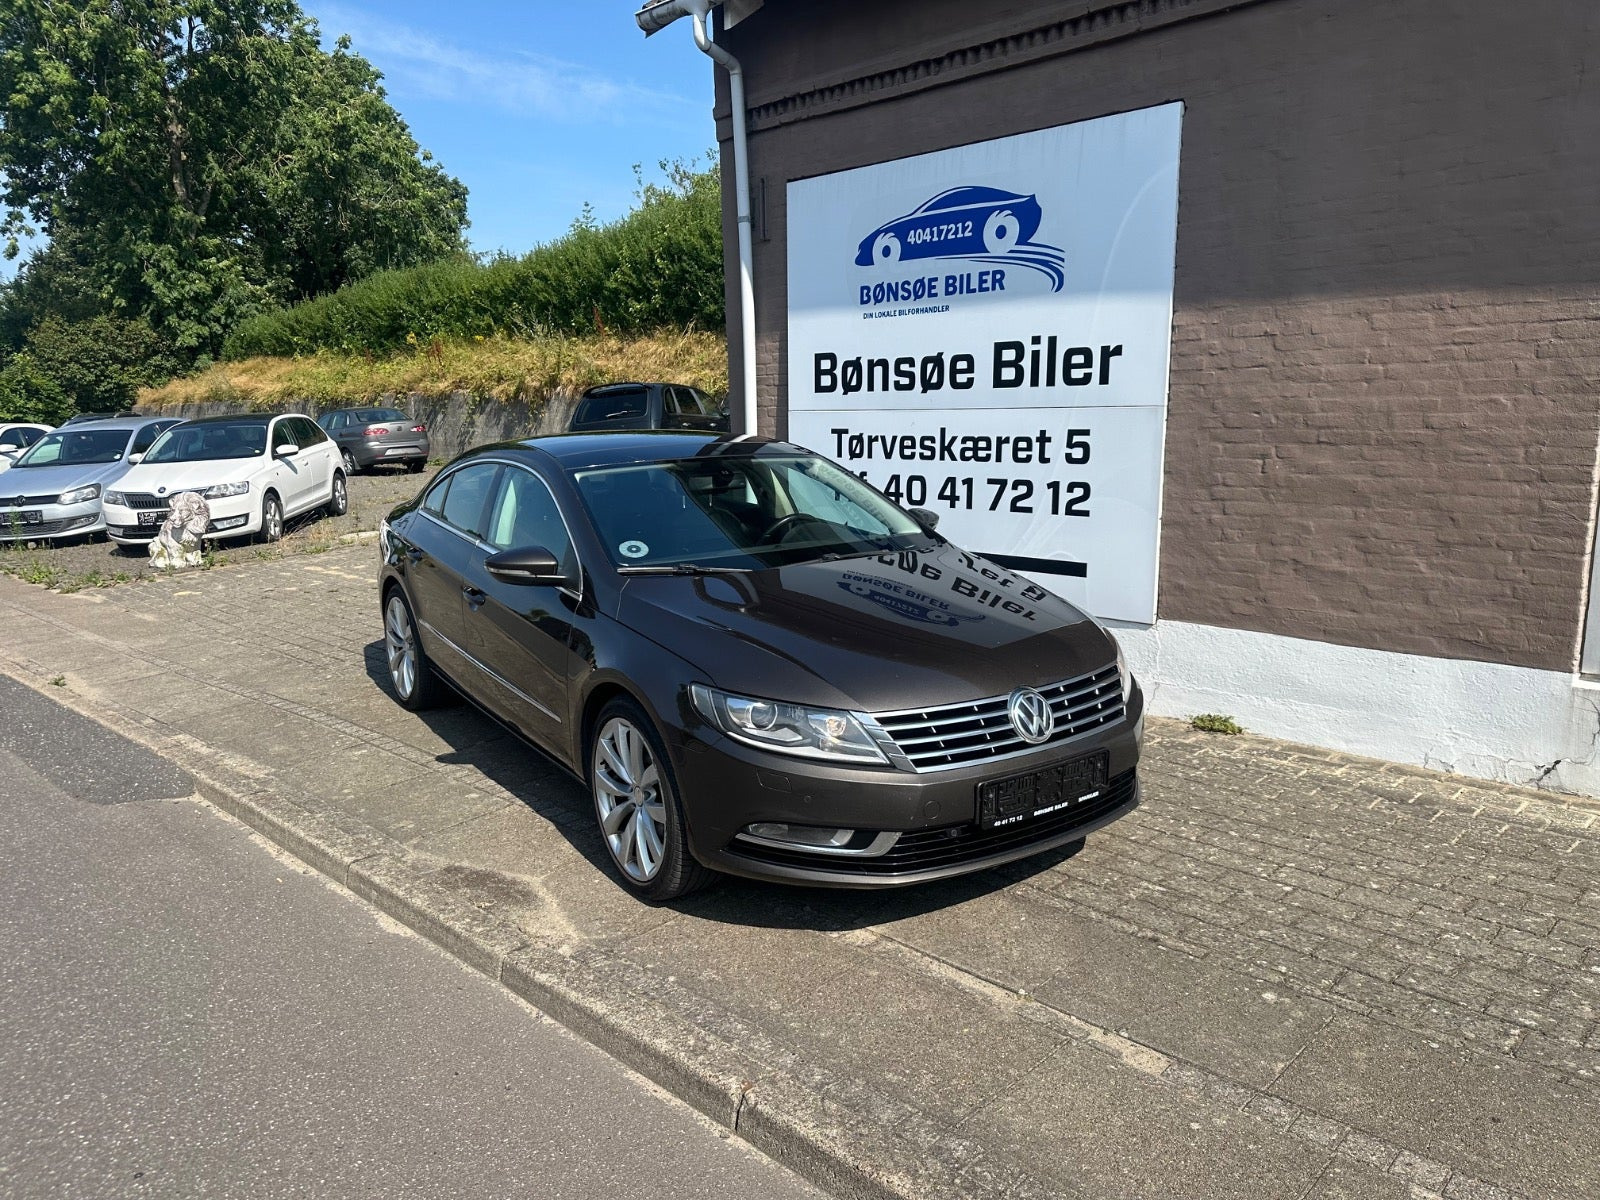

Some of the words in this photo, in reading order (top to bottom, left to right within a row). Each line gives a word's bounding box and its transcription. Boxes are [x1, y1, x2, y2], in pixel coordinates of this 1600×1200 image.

[906, 220, 973, 246] 40417212
[859, 276, 939, 306] BØNSØE
[944, 269, 1006, 297] BILER
[863, 312, 874, 320] DIN
[874, 309, 898, 319] LOKALE
[898, 304, 950, 317] BILFORHANDLER
[813, 351, 975, 396] Bønsøe
[992, 335, 1123, 389] Biler
[831, 427, 1052, 463] Tørveskæret
[1064, 428, 1091, 465] 5
[884, 473, 927, 507] 40
[938, 476, 973, 510] 41
[987, 478, 1034, 514] 72
[1046, 480, 1091, 517] 12
